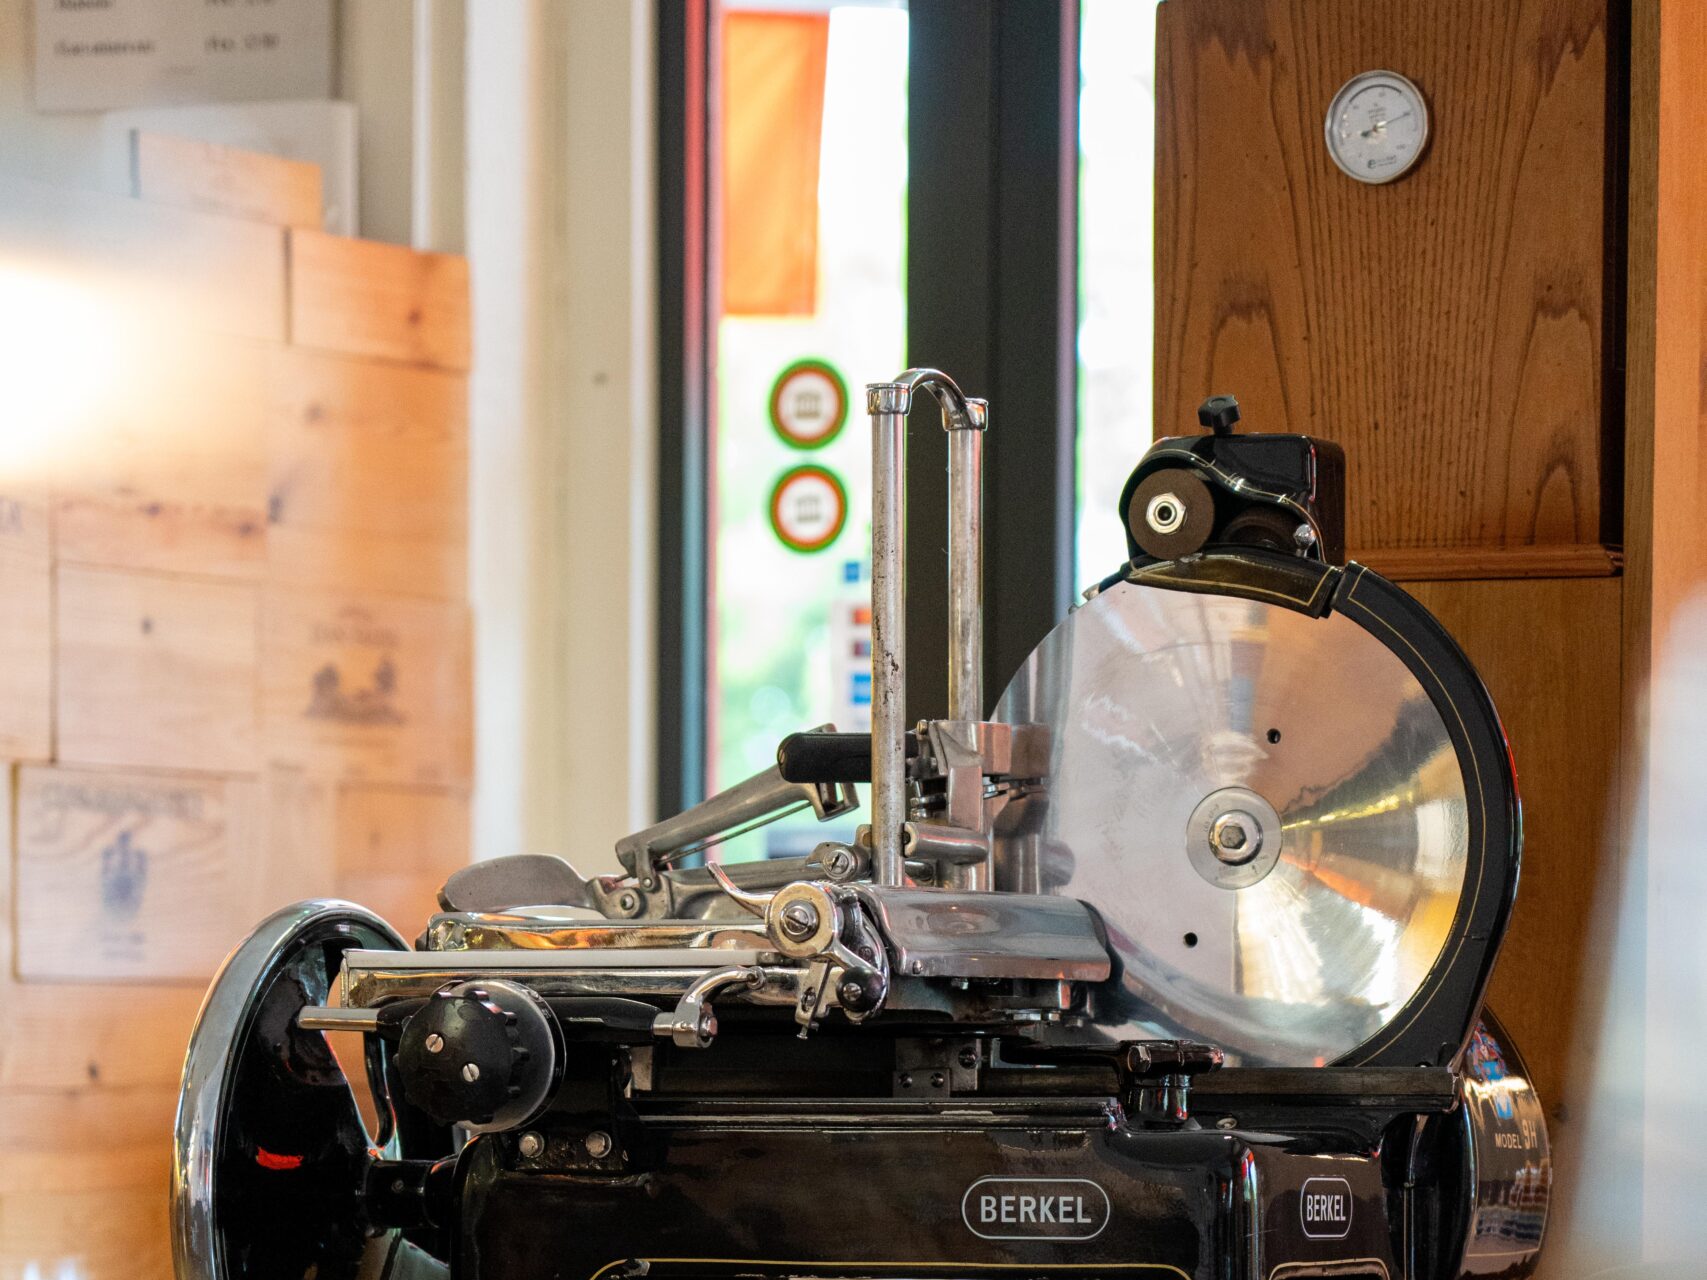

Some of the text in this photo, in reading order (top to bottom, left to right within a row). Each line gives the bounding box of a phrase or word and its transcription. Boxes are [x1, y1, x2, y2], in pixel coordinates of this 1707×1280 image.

[1495, 1119, 1538, 1149] MODEL 9H
[980, 1195, 1092, 1223] BERKEL
[1306, 1194, 1347, 1222] BERKEL
